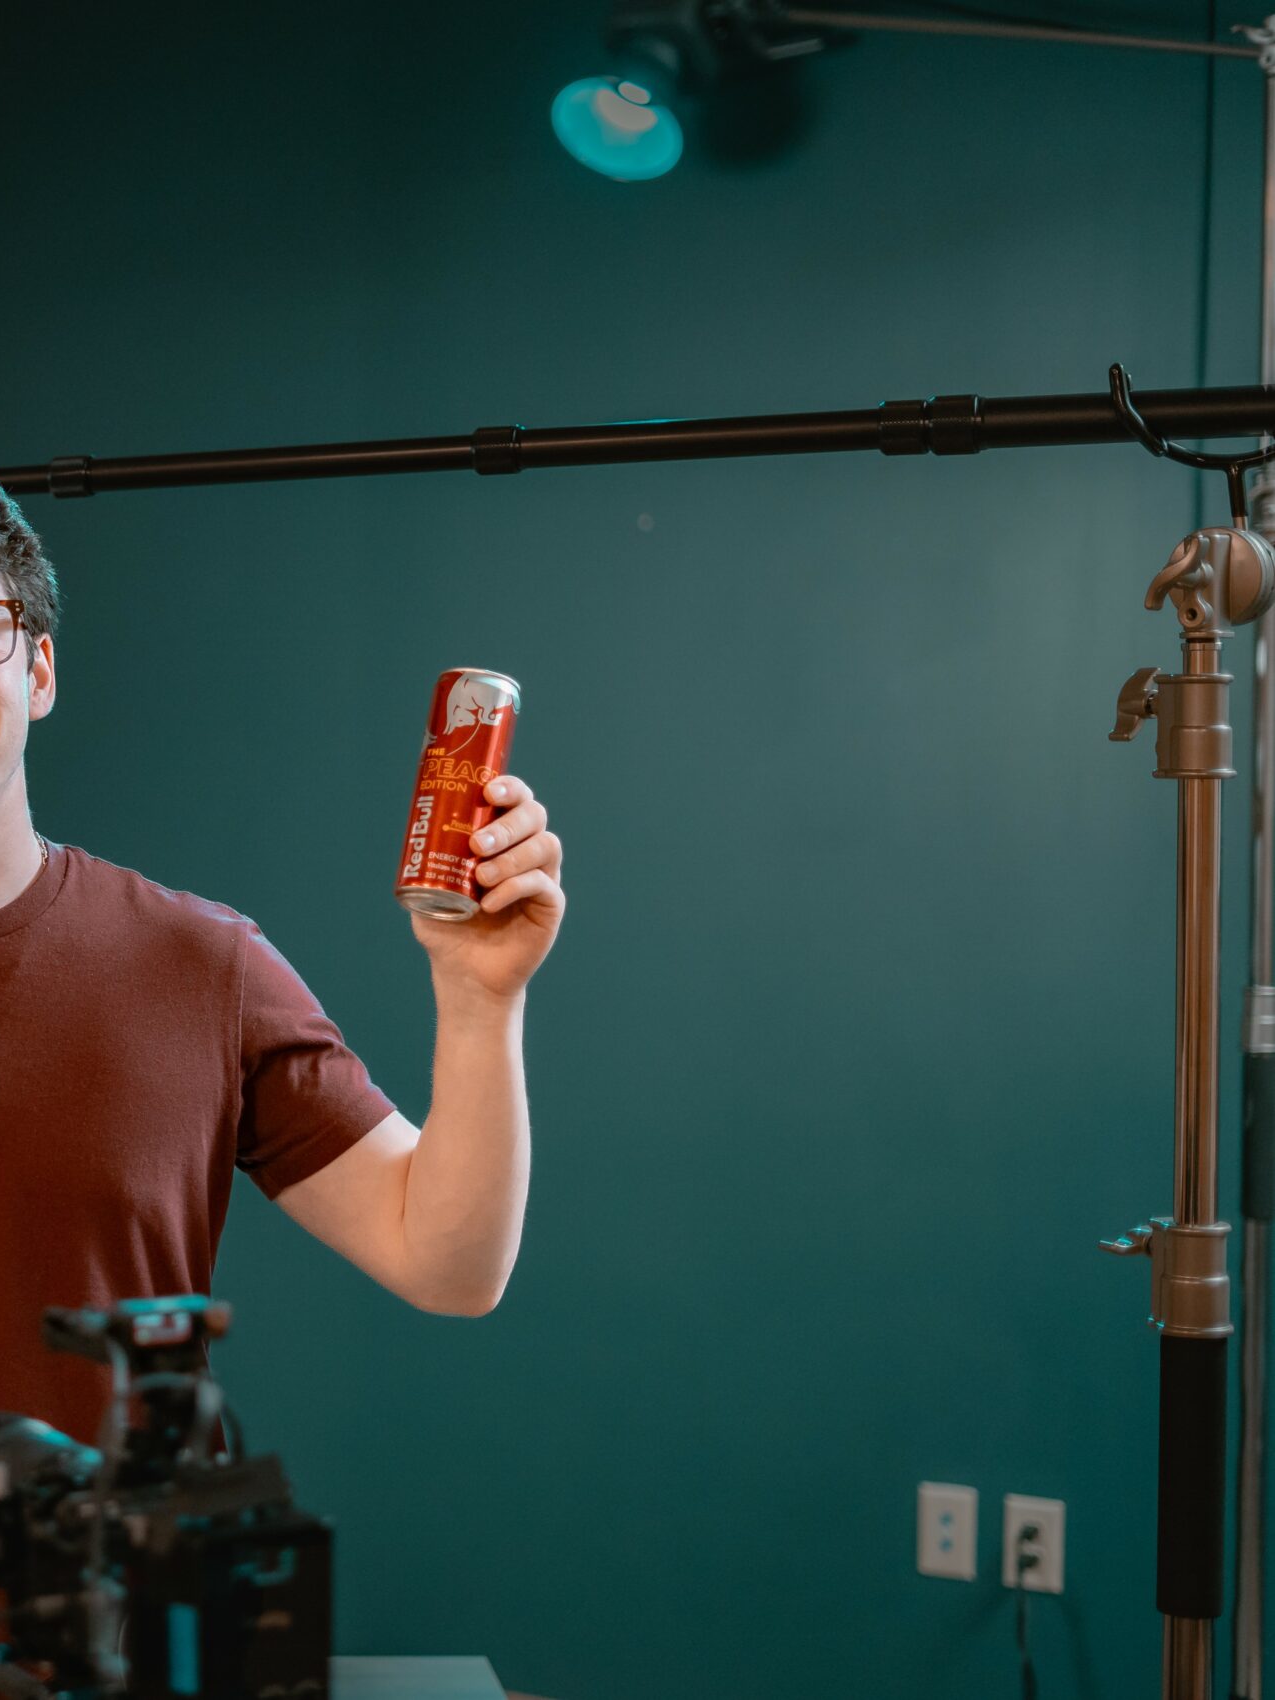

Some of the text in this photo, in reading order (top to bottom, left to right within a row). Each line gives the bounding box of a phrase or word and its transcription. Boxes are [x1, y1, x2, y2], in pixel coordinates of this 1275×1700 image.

[427, 747, 445, 757] THE
[423, 757, 499, 785] PEAC
[420, 779, 467, 793] EDITION
[403, 795, 434, 878] Red Bull
[428, 851, 460, 863] ENERGY
